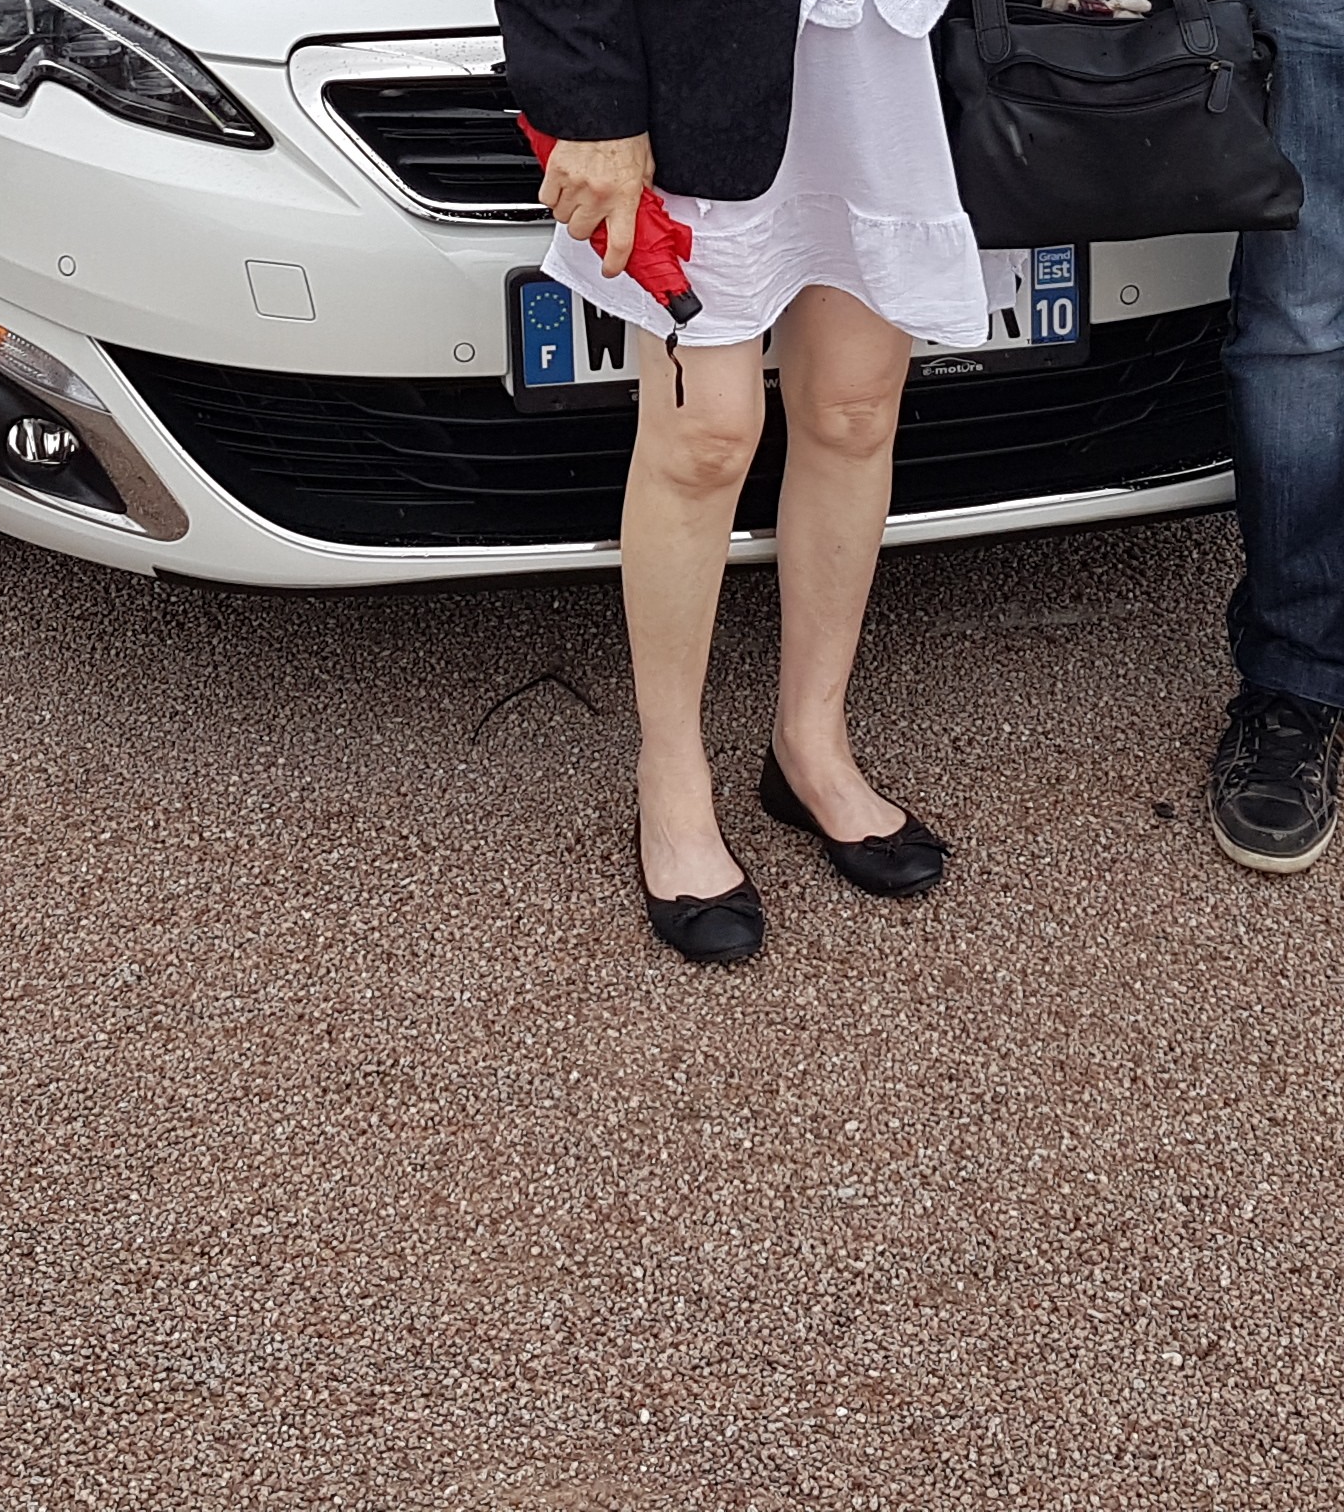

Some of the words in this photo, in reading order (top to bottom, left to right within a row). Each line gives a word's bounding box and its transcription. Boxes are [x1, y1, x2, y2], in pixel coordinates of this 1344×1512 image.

[1039, 250, 1071, 262] Grand
[1038, 261, 1071, 279] Est
[1036, 298, 1073, 337] 10
[541, 344, 557, 369] F
